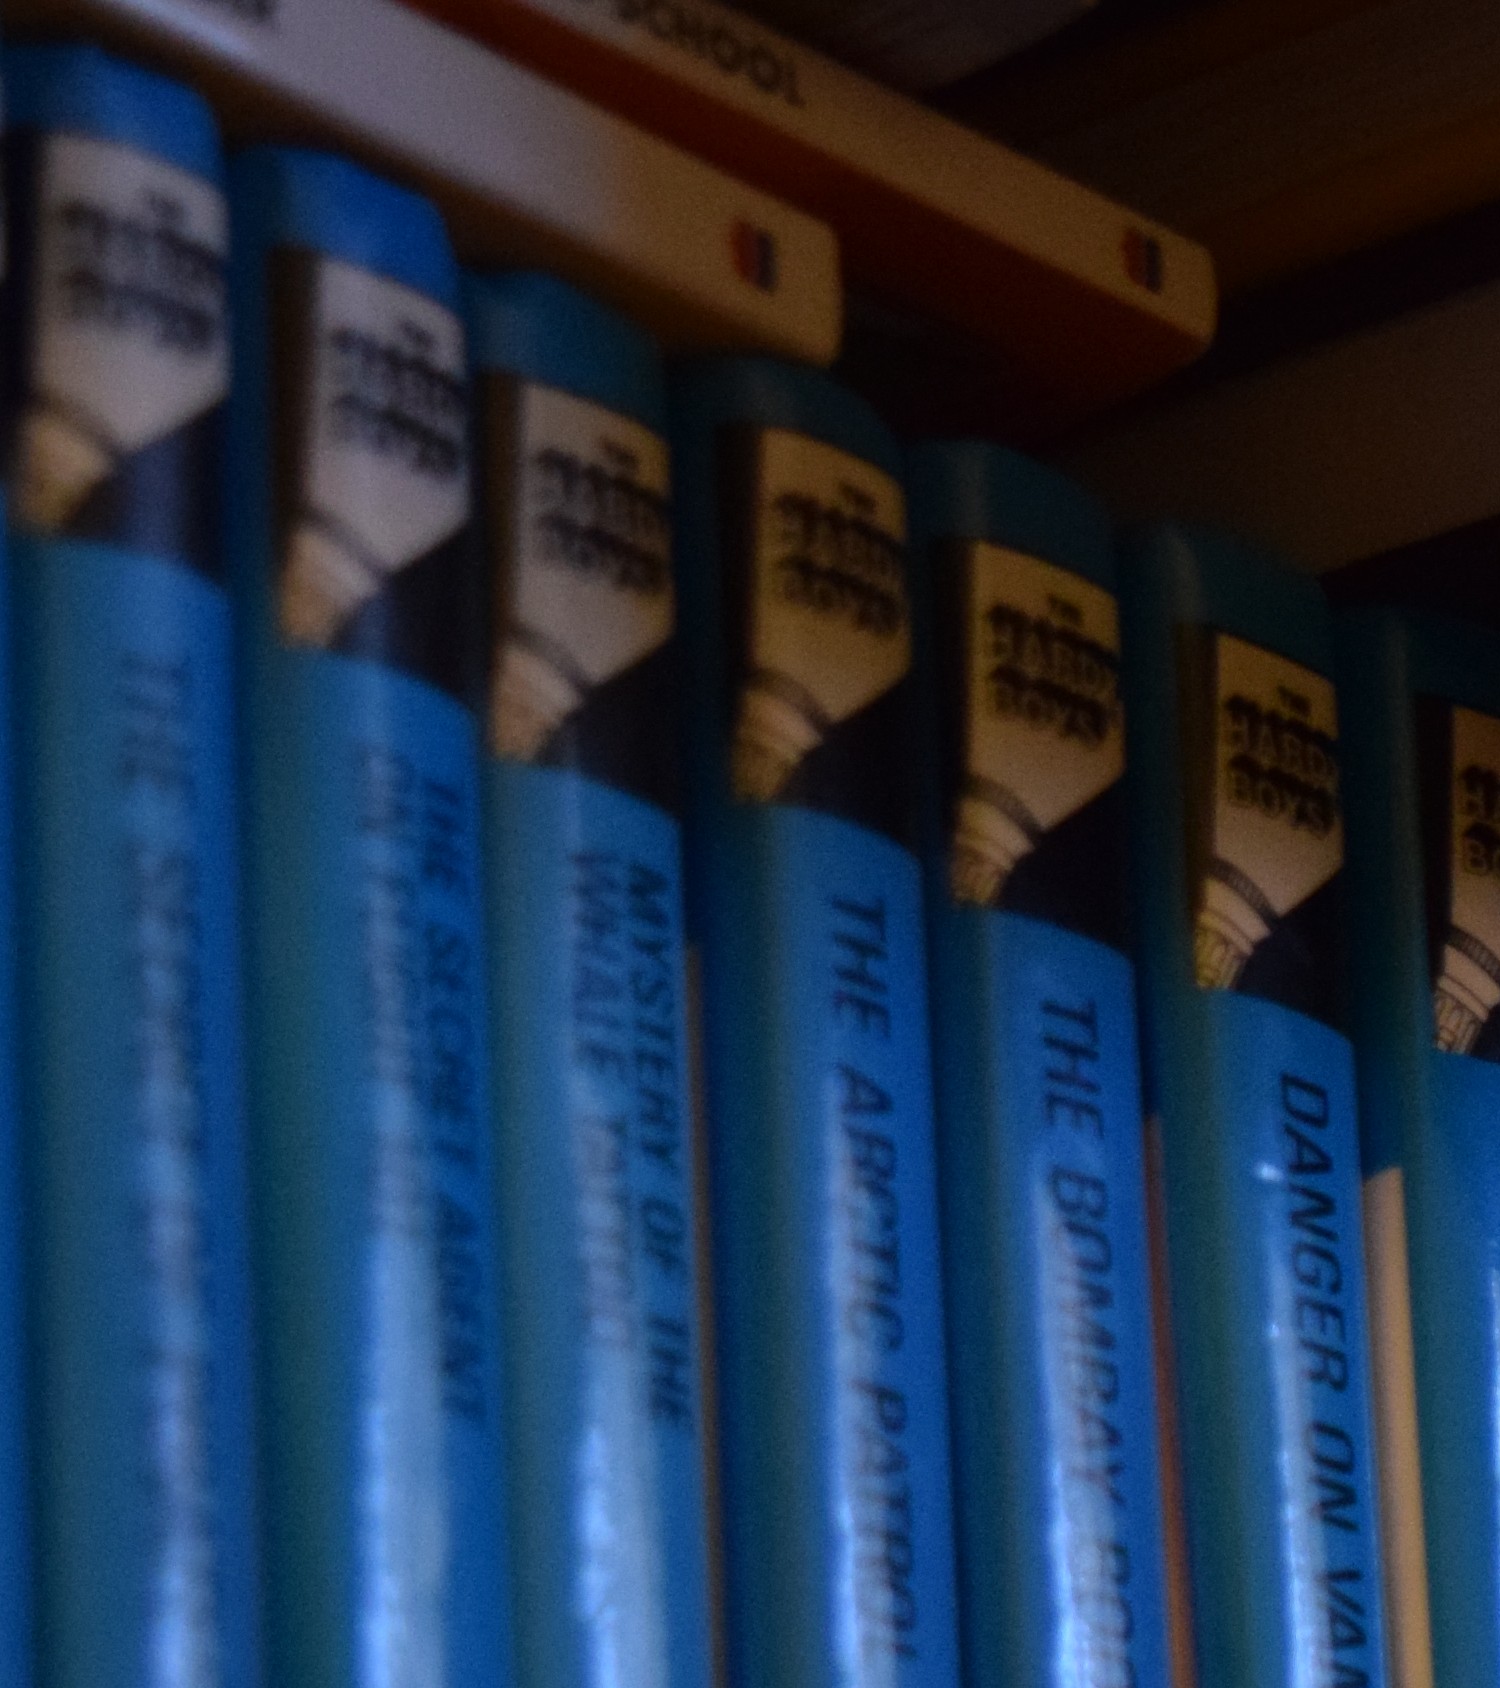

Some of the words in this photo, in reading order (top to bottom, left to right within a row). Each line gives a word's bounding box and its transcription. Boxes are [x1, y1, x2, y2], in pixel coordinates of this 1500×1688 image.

[626, 858, 680, 1172] MYSTERY
[829, 891, 891, 1039] THE
[1040, 1002, 1104, 1138] THE
[643, 1195, 687, 1268] OF
[1279, 1070, 1349, 1396] DANGER
[1308, 1421, 1360, 1533] ON
